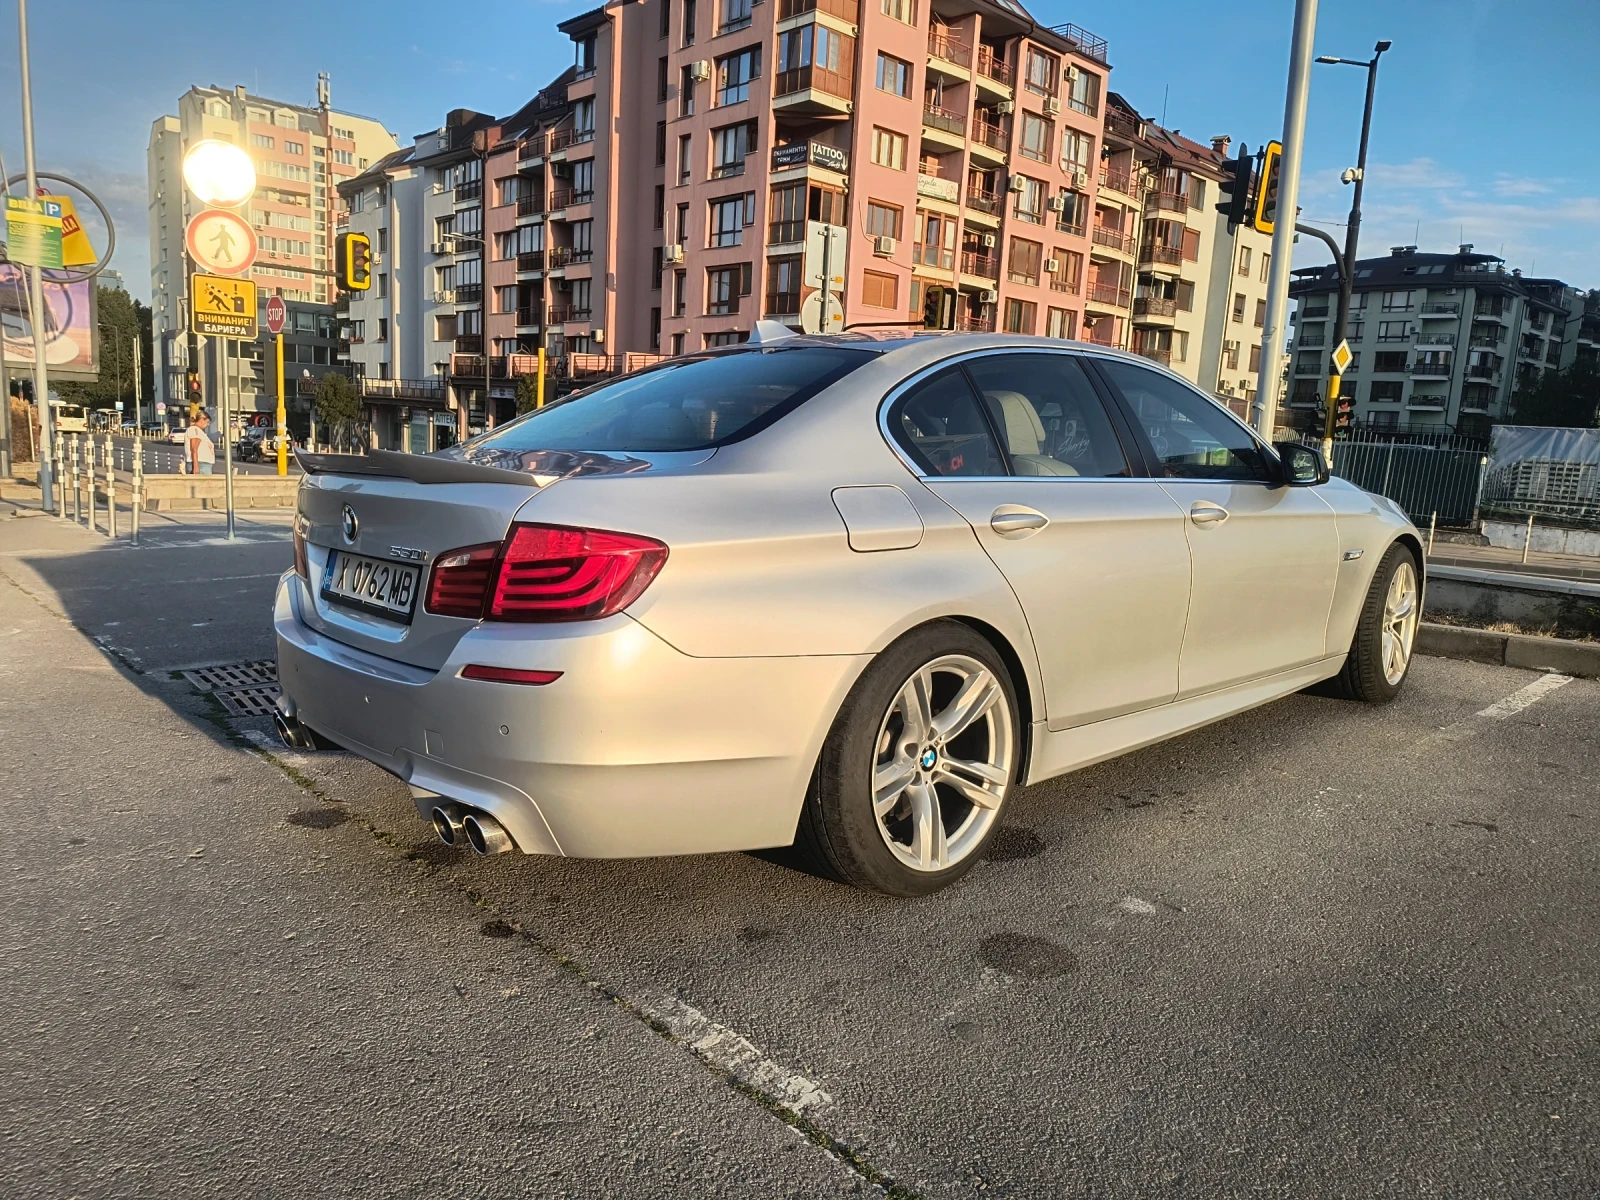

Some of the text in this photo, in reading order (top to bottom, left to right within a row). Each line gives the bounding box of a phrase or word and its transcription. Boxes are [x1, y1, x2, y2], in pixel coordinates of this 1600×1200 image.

[812, 143, 843, 160] TATTOO
[8, 198, 43, 213] BILLA
[198, 313, 253, 327] ВНИМАНИЕ!
[268, 307, 283, 321] STOP
[204, 323, 247, 336] БАРИЕРА
[352, 560, 389, 600] 0762
